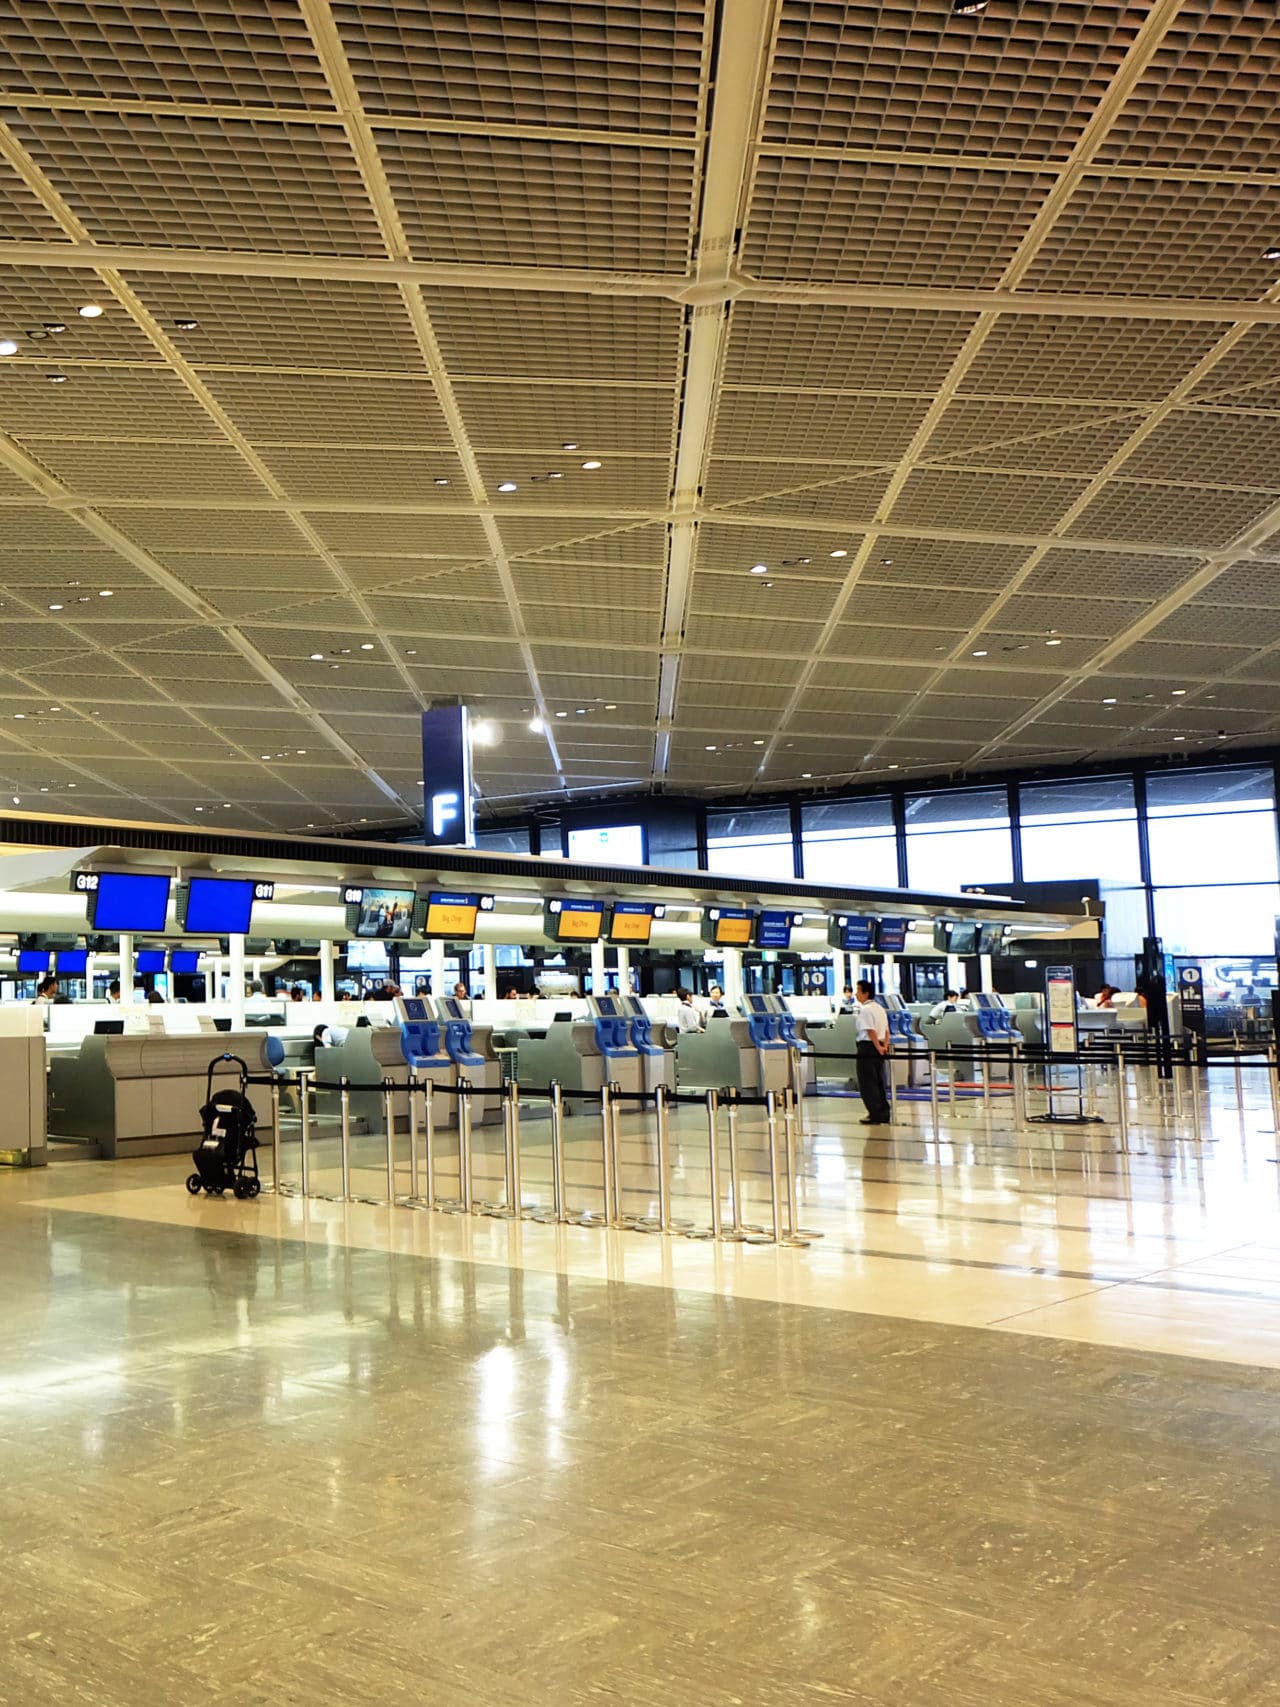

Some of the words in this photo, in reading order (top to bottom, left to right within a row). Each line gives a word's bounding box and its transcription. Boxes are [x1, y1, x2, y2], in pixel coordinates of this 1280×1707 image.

[432, 793, 458, 836] F
[76, 874, 99, 890] G12
[255, 884, 273, 898] G11
